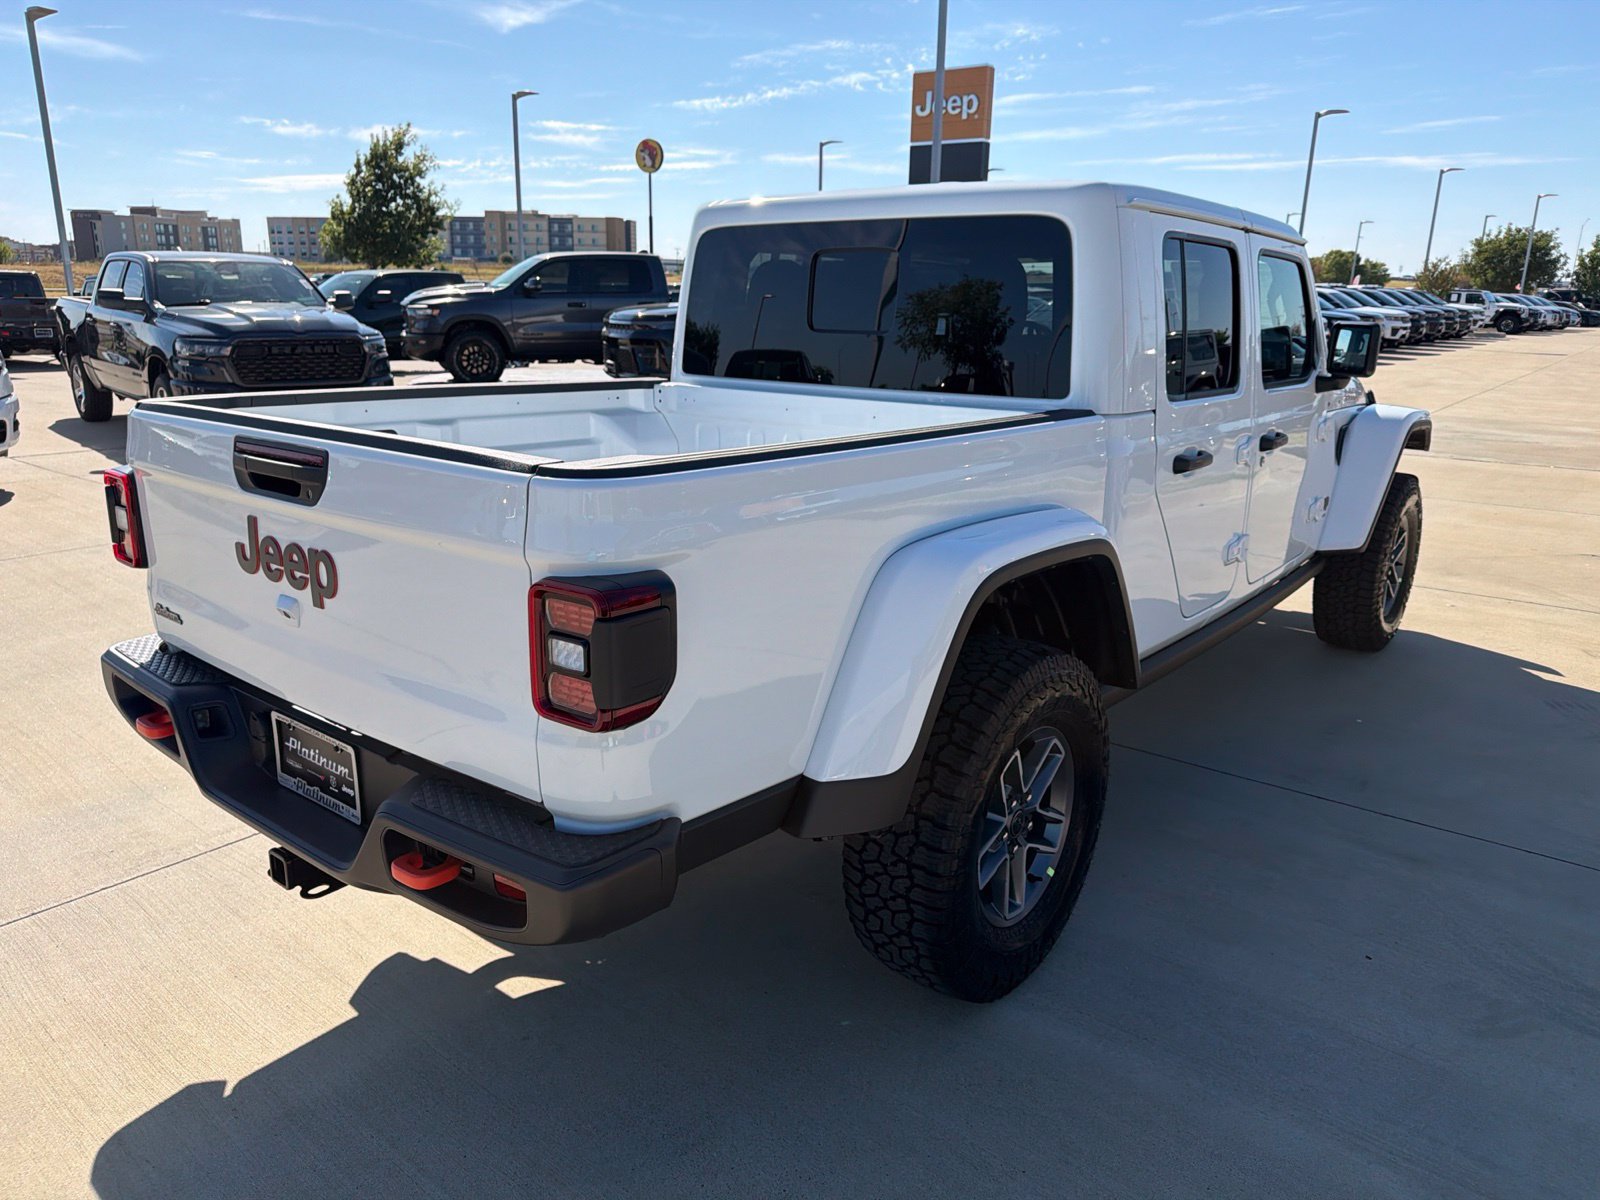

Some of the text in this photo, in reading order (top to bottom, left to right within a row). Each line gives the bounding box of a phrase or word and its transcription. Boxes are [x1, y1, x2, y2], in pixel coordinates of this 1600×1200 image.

[271, 344, 335, 355] RAM
[235, 515, 338, 609] Jeep
[285, 736, 353, 781] Platinum
[296, 778, 343, 814] Platinum
